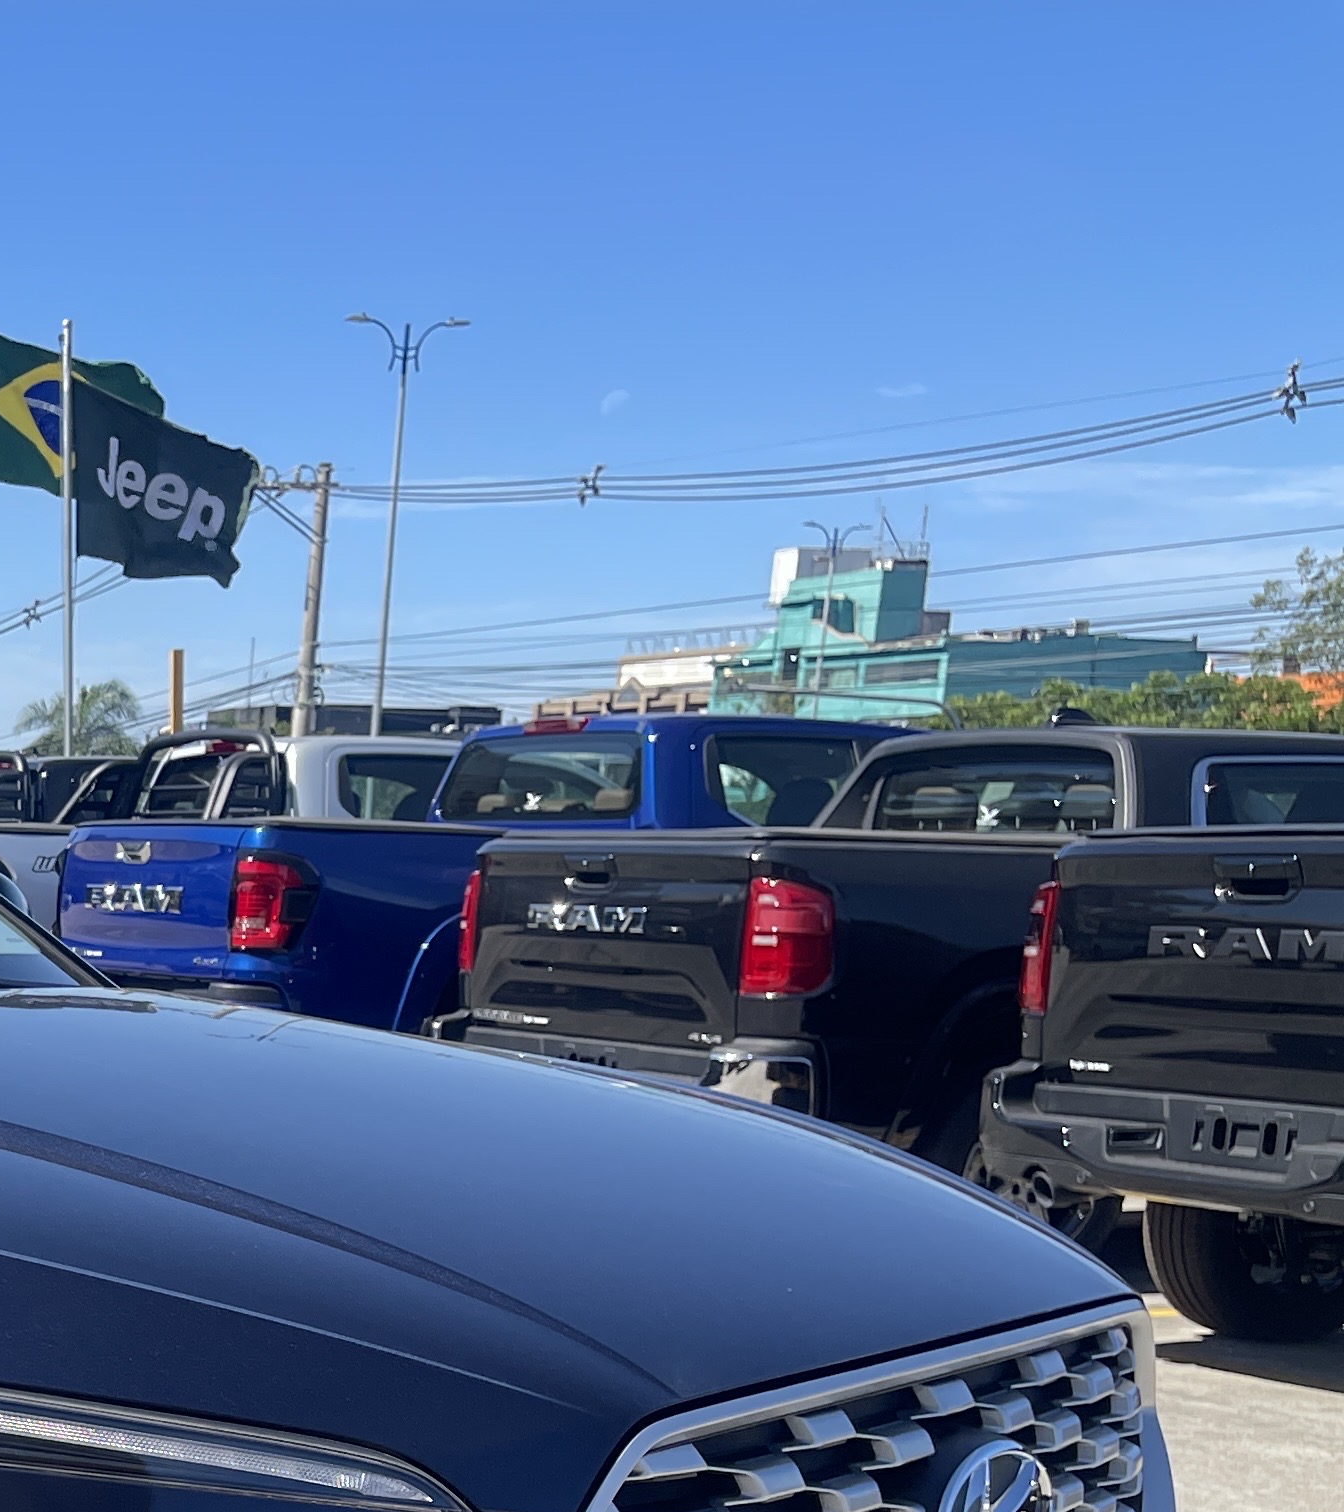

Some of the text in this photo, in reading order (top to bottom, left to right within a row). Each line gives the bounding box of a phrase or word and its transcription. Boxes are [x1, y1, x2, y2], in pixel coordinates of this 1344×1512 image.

[96, 437, 226, 543] Jeep
[84, 882, 184, 915] RAM
[526, 902, 648, 934] RAM
[1147, 924, 1344, 962] RAM
